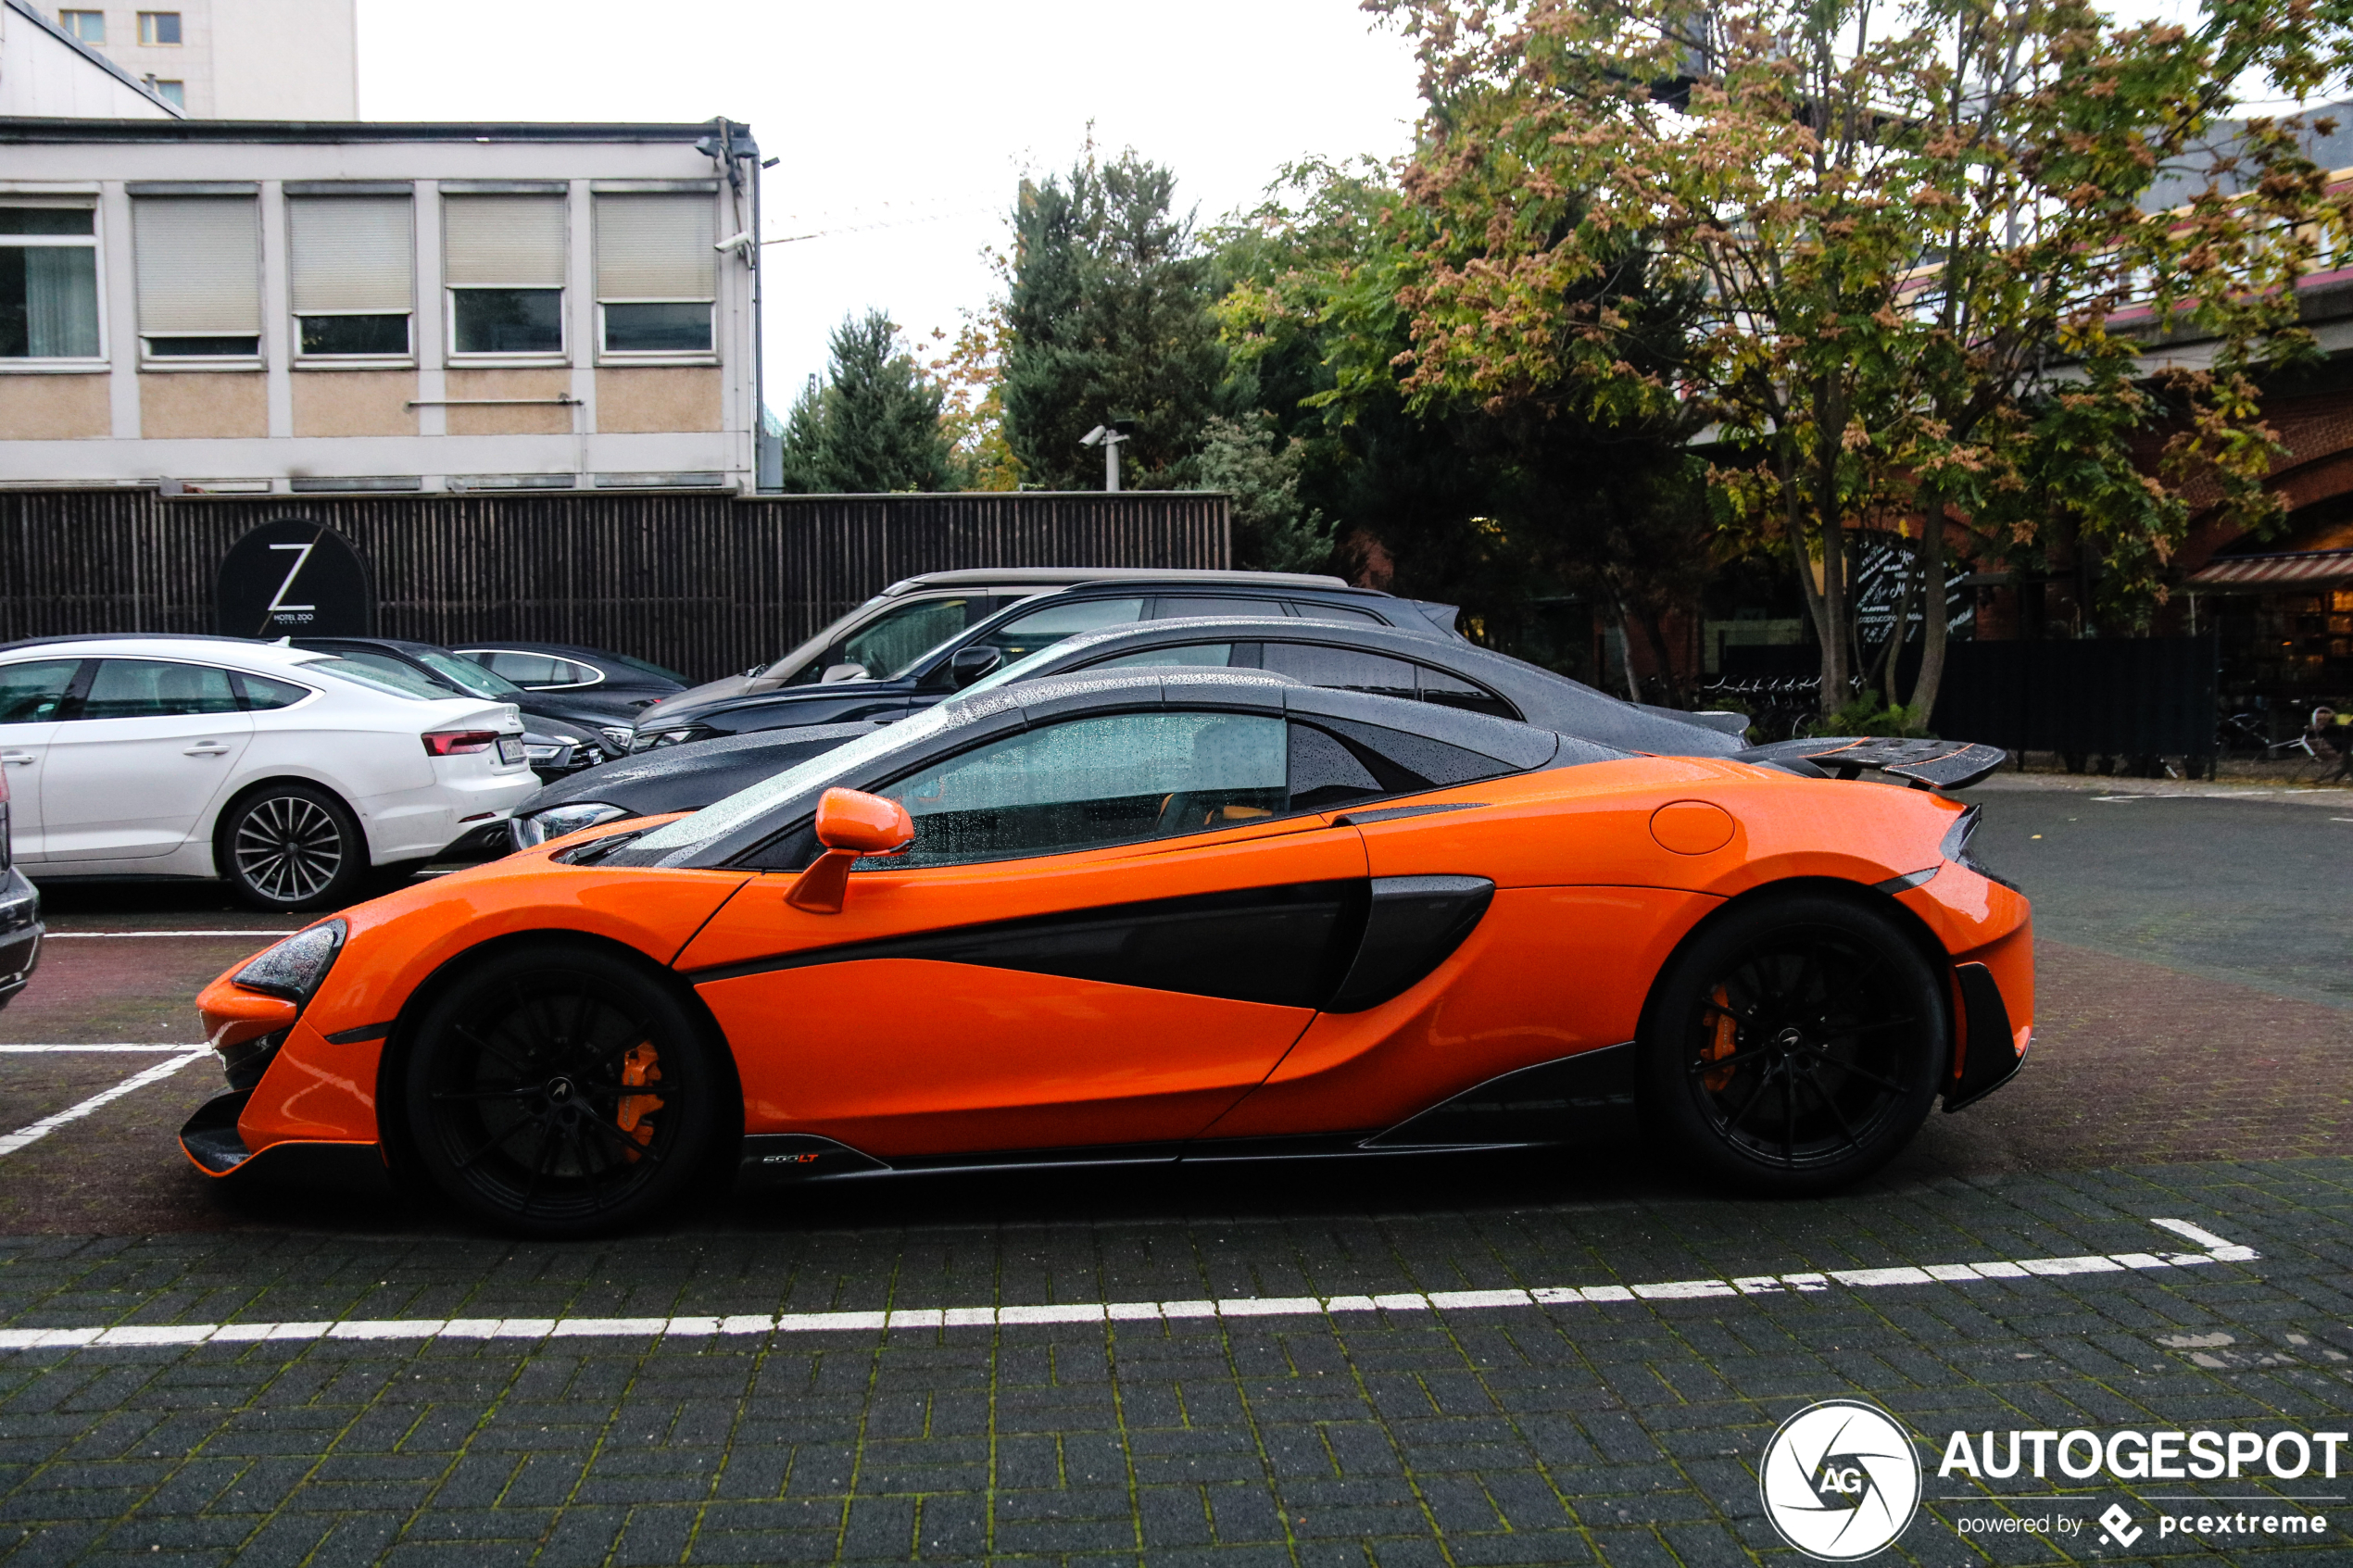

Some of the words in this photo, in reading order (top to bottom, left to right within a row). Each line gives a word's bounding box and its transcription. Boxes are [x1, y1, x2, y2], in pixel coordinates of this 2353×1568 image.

[268, 544, 316, 611] Z
[297, 613, 314, 621] ZOO
[762, 1154, 818, 1163] 600LT
